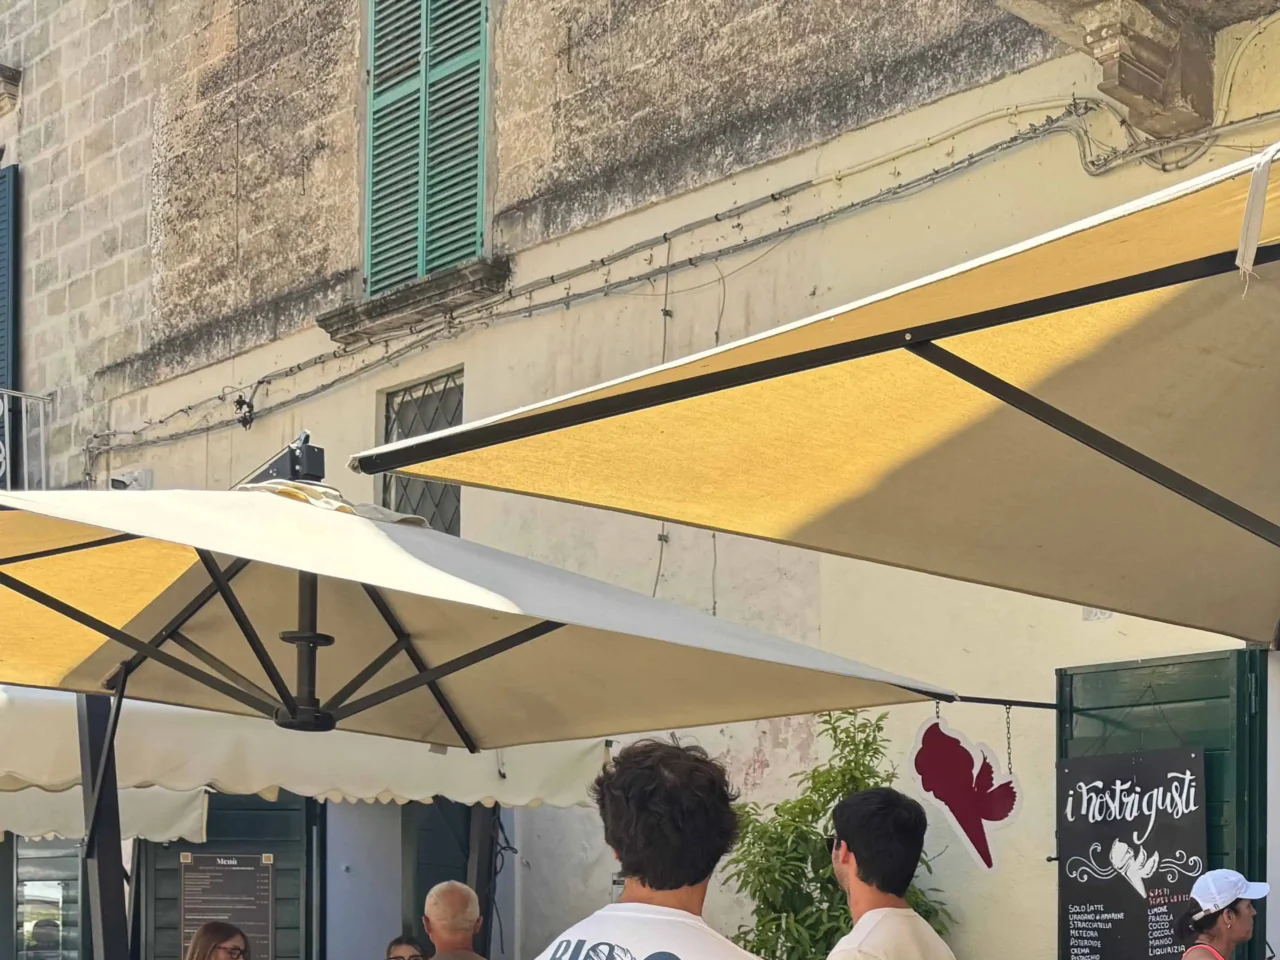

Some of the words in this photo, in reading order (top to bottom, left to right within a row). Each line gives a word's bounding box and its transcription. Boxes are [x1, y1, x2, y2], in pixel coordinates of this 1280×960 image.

[1065, 790, 1075, 822] i
[1076, 779, 1141, 823] nostri
[1133, 769, 1199, 845] gusti
[1068, 904, 1086, 913] SOLO
[1086, 903, 1104, 912] LATTE
[1147, 905, 1168, 915] LIMONE
[1148, 922, 1170, 930] COCCO
[1070, 929, 1098, 938] METEORA
[1149, 937, 1173, 947] MANGO
[1149, 944, 1186, 956] LIQUIRIZIA
